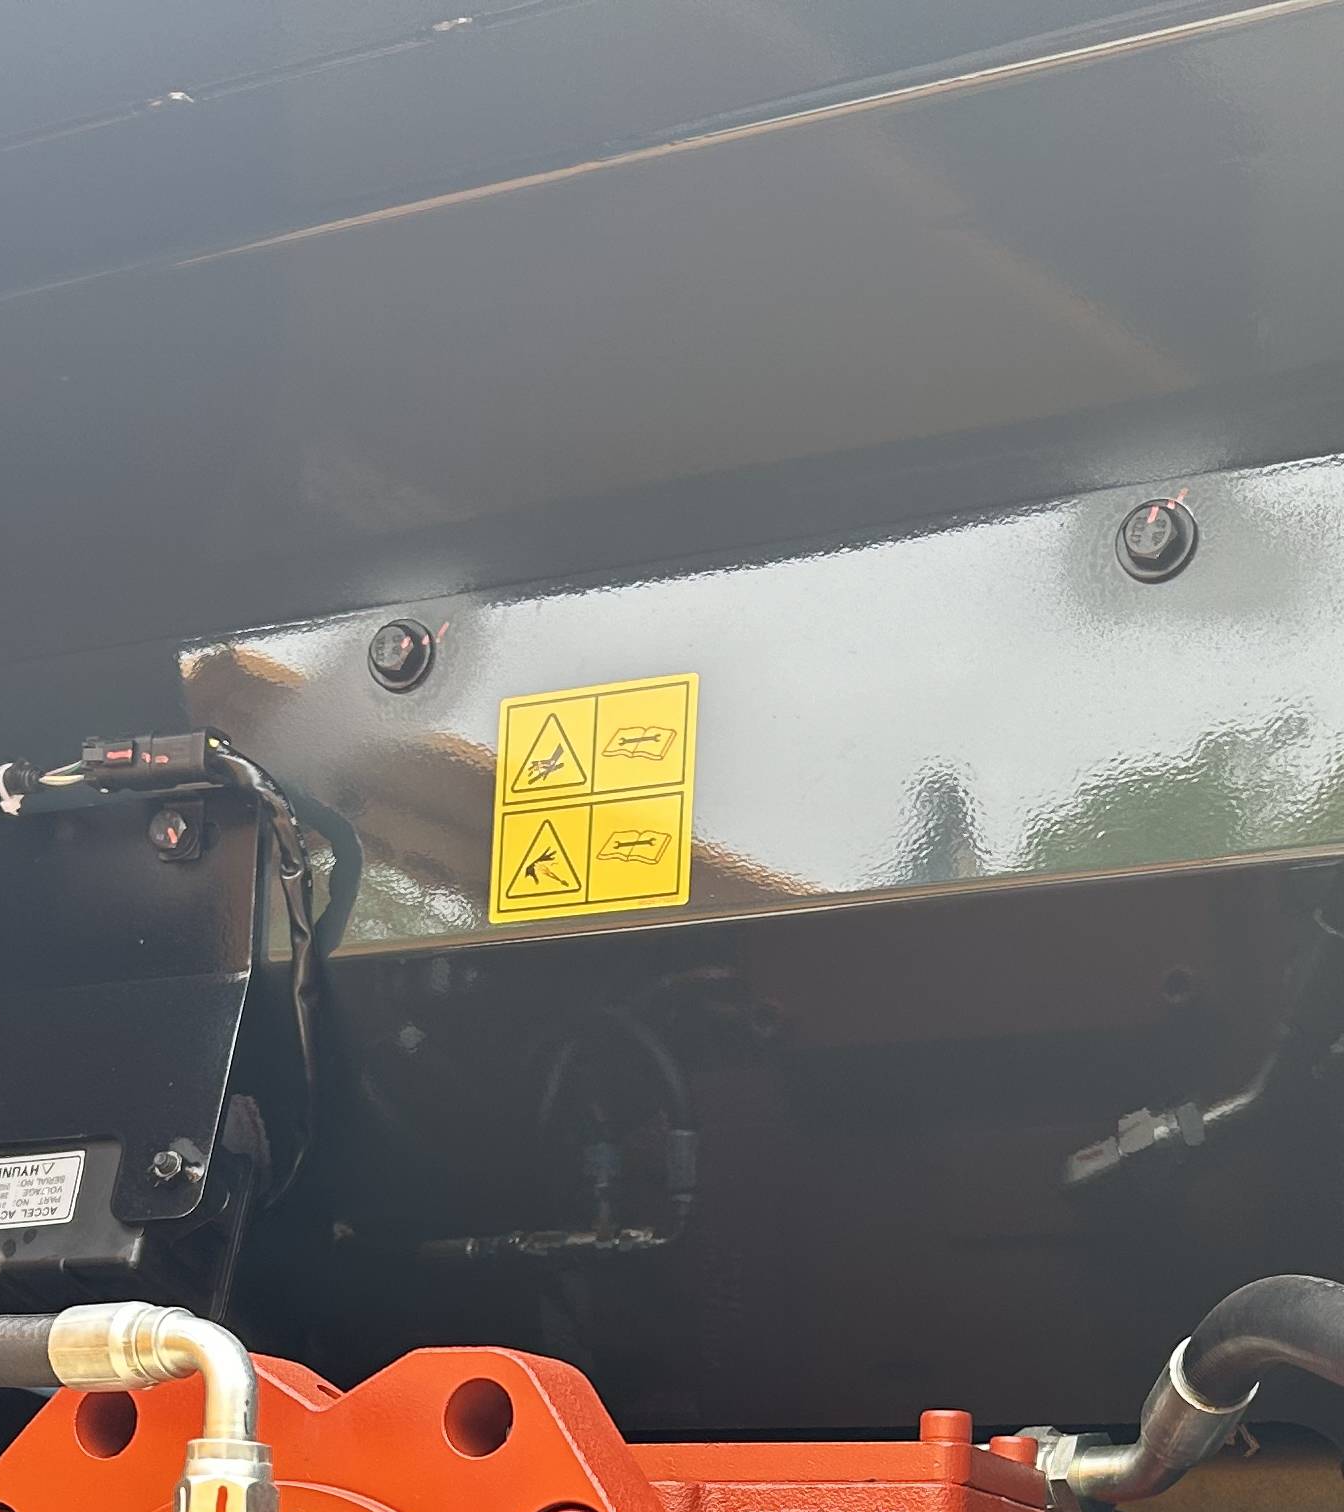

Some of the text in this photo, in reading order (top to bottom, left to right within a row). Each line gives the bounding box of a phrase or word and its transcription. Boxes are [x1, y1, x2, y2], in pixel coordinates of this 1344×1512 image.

[36, 1174, 66, 1186] SERIAL
[22, 1185, 63, 1197] VOLTAGE
[38, 1195, 62, 1206] PART
[21, 1206, 58, 1219] ACCEL
